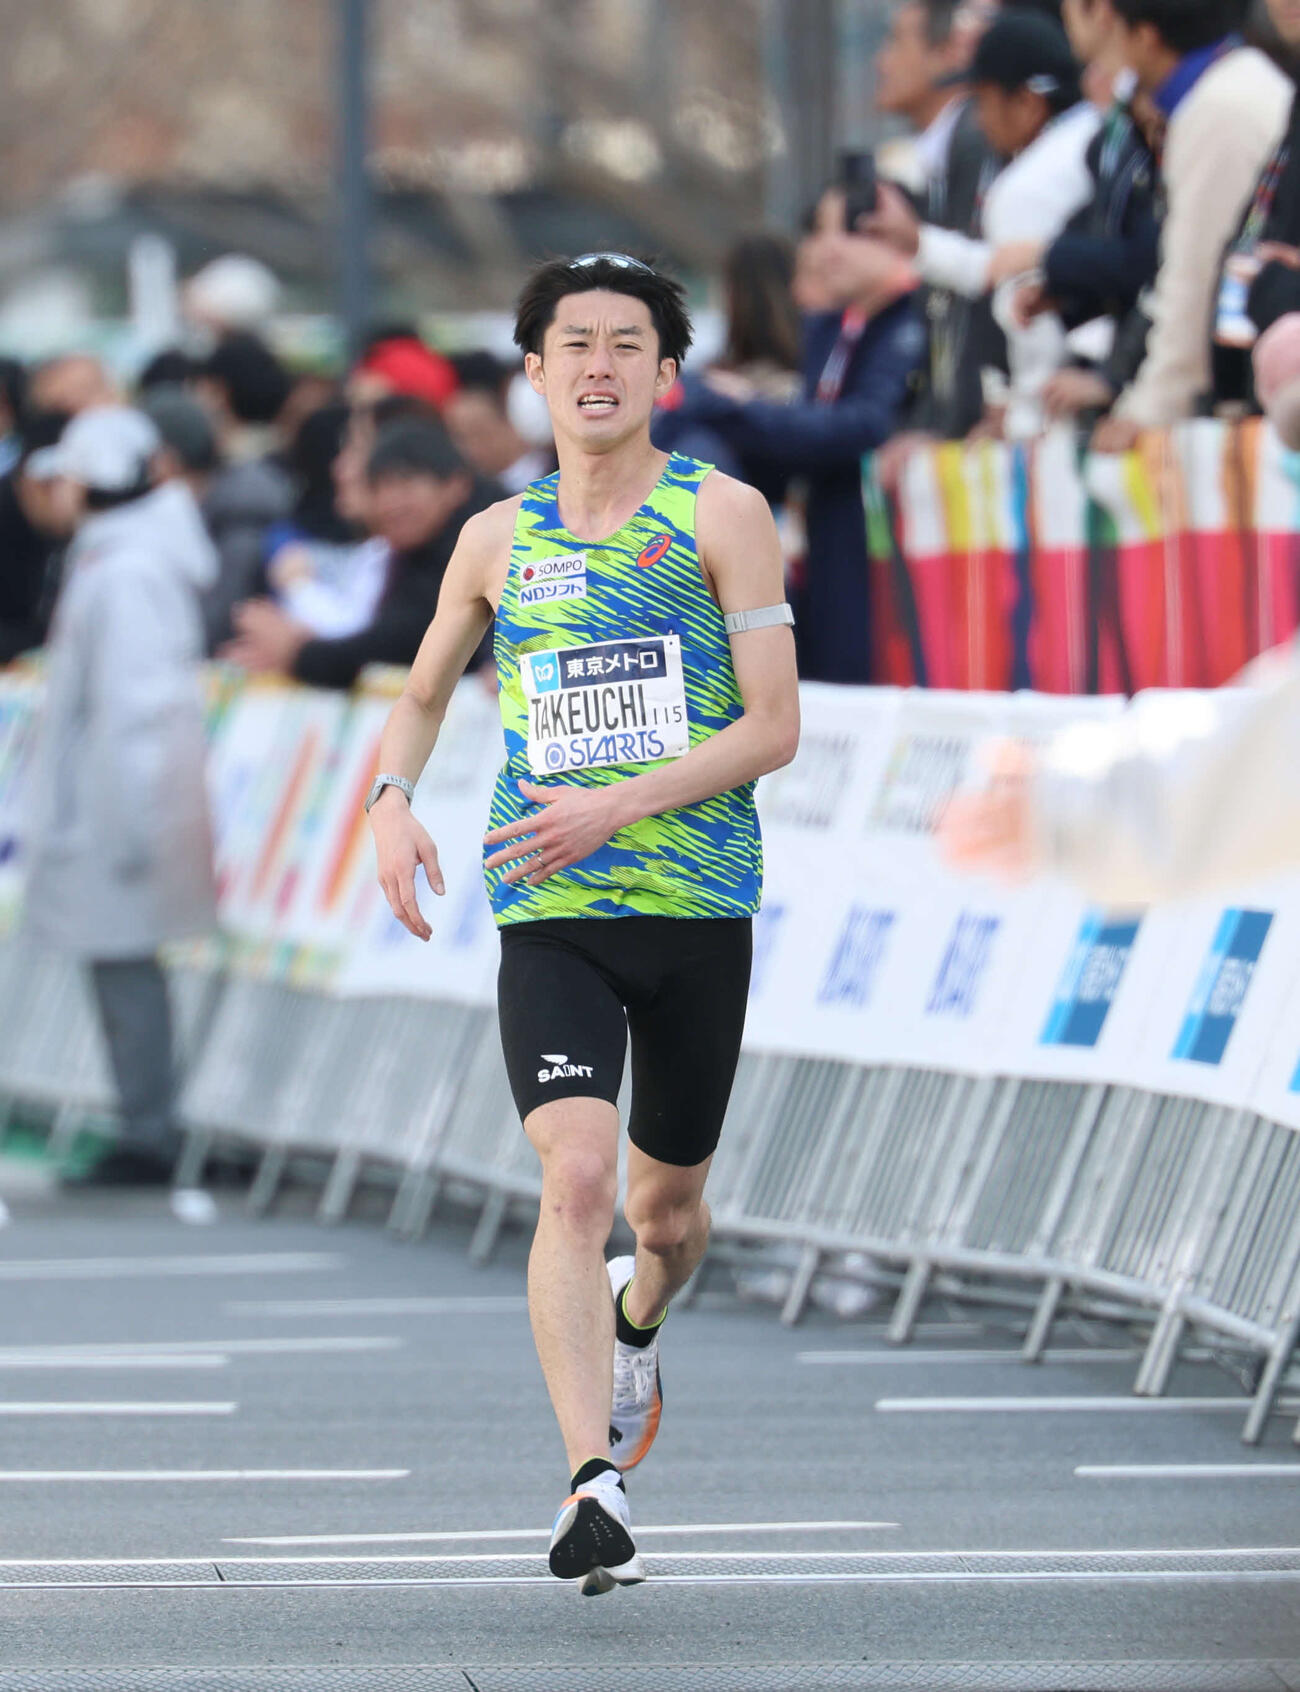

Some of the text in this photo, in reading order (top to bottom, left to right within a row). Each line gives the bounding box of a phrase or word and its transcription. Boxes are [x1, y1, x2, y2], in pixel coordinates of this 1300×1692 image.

[538, 560, 583, 576] SOMPO
[520, 583, 583, 603] NDソフト
[566, 651, 658, 678] 東京メトロ
[531, 684, 647, 740] TAKEUCHI
[653, 706, 682, 725] 115
[537, 1064, 594, 1083] SAINT
